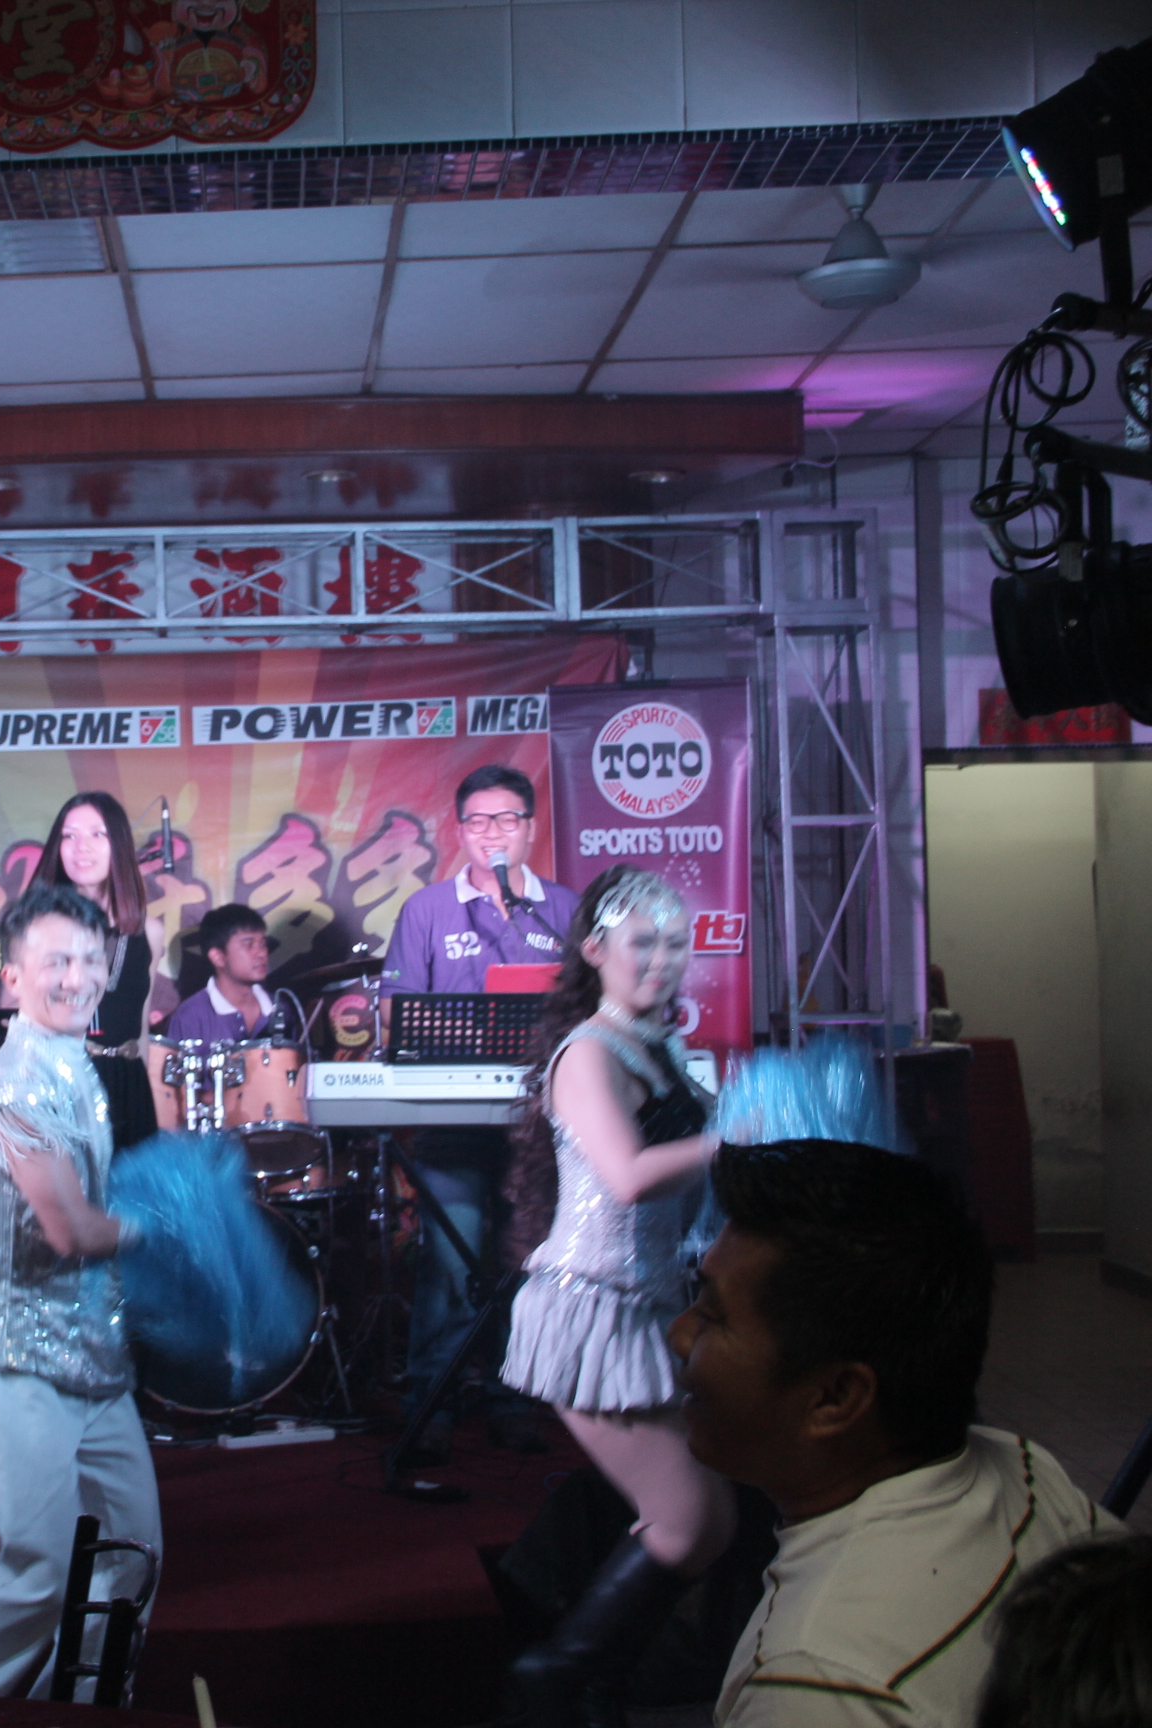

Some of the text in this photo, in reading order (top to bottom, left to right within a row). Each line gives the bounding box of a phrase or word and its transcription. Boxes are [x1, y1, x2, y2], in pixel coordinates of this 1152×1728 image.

[204, 701, 415, 742] POWER
[621, 707, 678, 729] SPORTS
[600, 741, 704, 780] TOTO
[615, 788, 690, 815] MALAYSIA
[579, 825, 724, 856] SPORTS TOTO
[444, 930, 482, 960] 52
[525, 932, 554, 951] MEGA
[338, 1073, 385, 1086] YAMAHA
